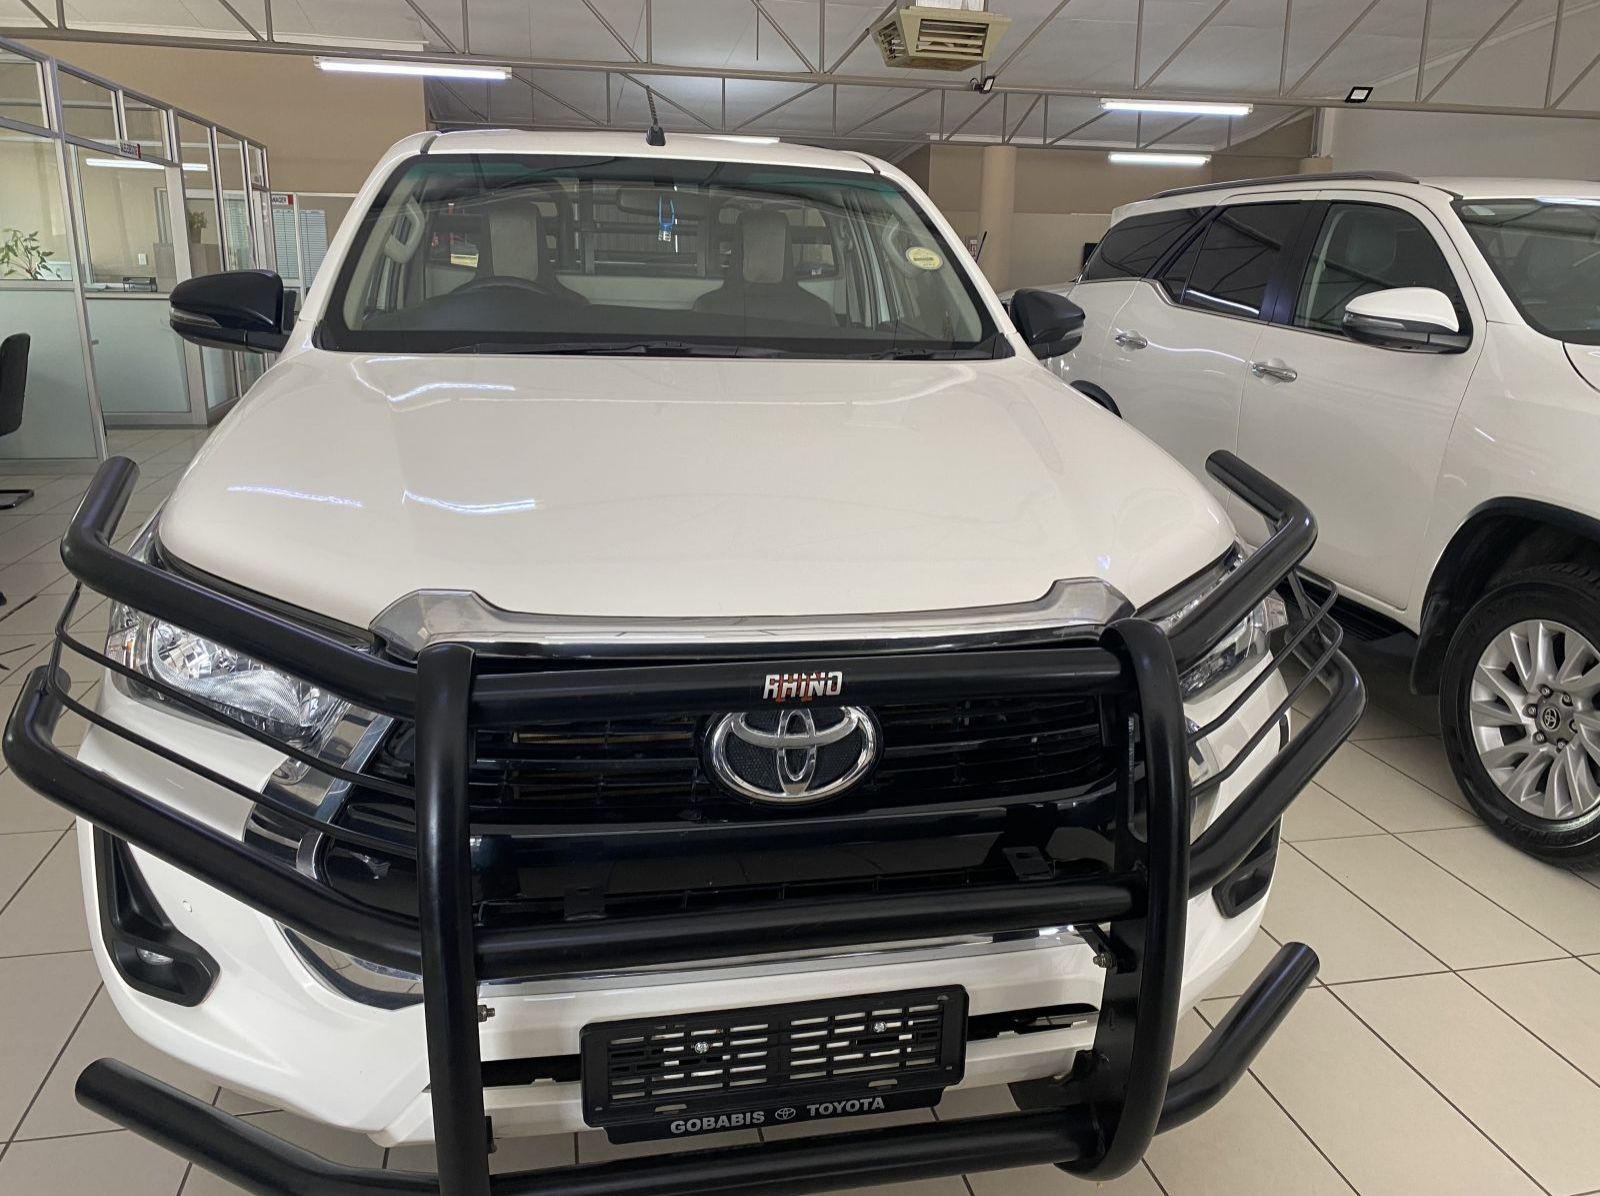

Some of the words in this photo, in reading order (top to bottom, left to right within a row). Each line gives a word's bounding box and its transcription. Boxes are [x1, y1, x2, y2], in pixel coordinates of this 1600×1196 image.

[763, 671, 843, 700] RHINO
[670, 1111, 765, 1134] GOBABIS
[806, 1096, 885, 1117] TOYOTA
